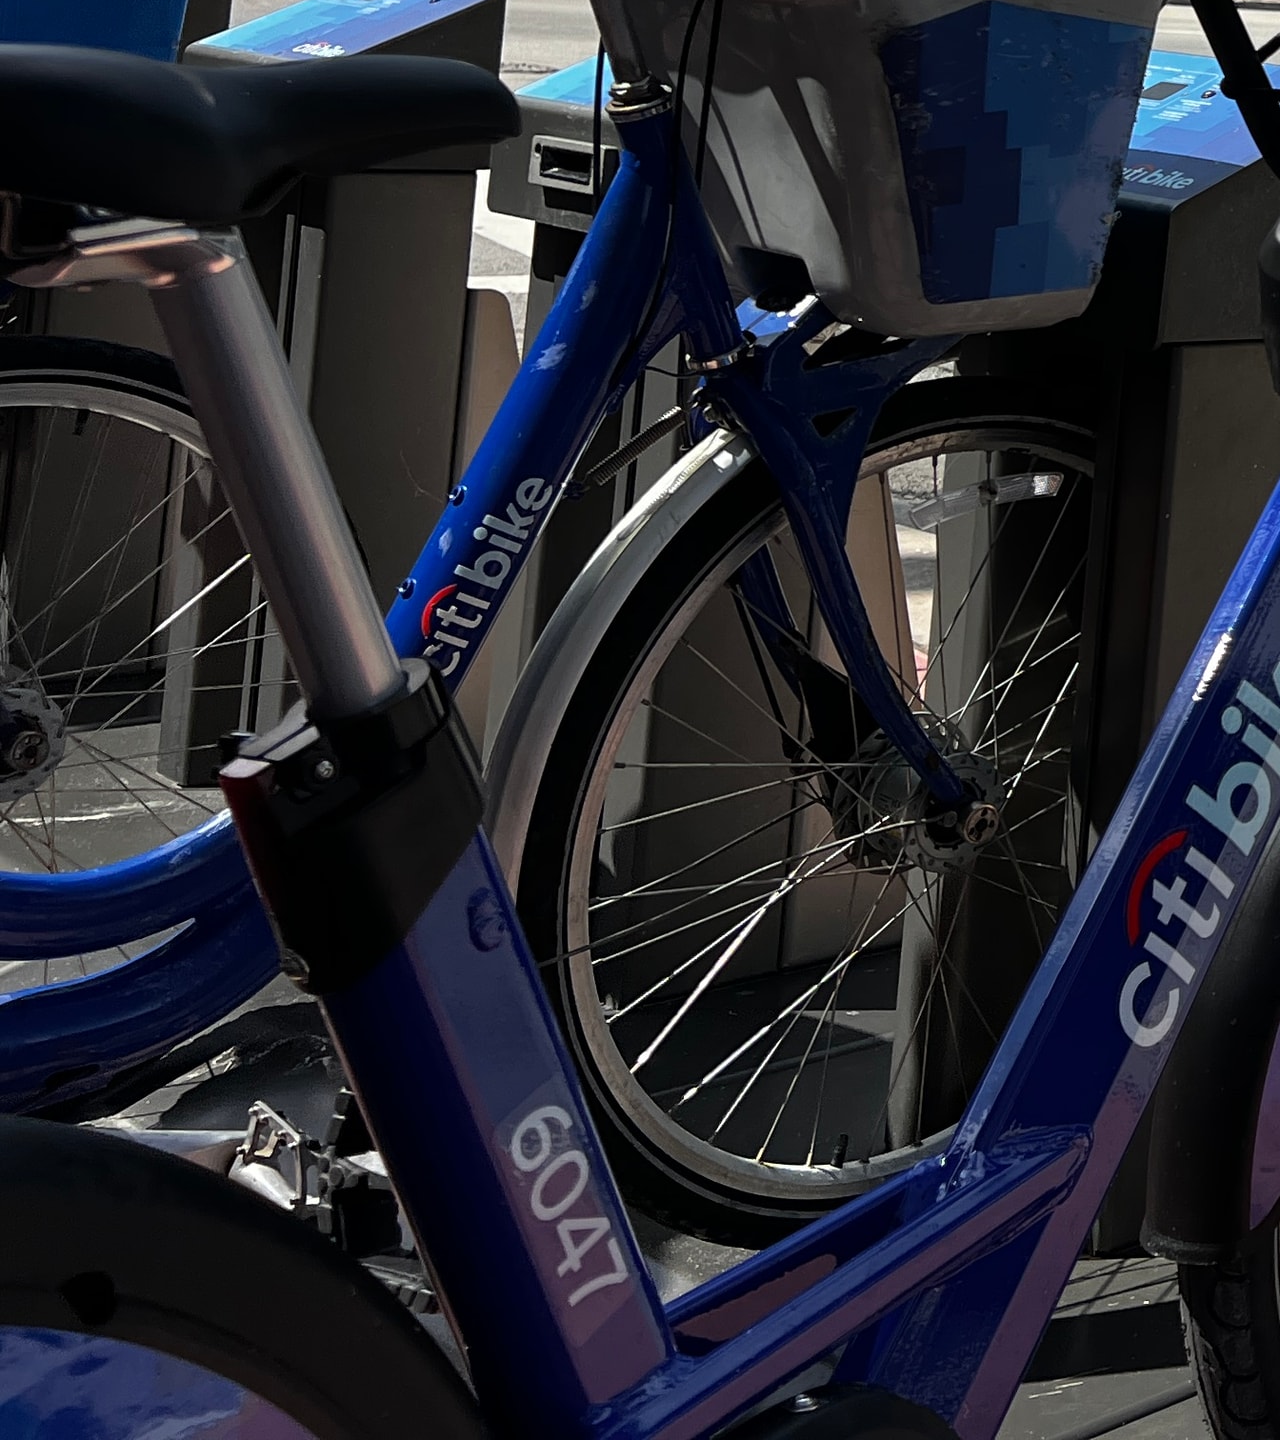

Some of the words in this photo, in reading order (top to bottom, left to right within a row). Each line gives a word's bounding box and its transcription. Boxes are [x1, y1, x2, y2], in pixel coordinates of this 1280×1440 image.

[1142, 169, 1195, 190] bike
[454, 476, 554, 592] bike
[1118, 834, 1236, 1048] citi
[508, 1103, 630, 1308] 6047
